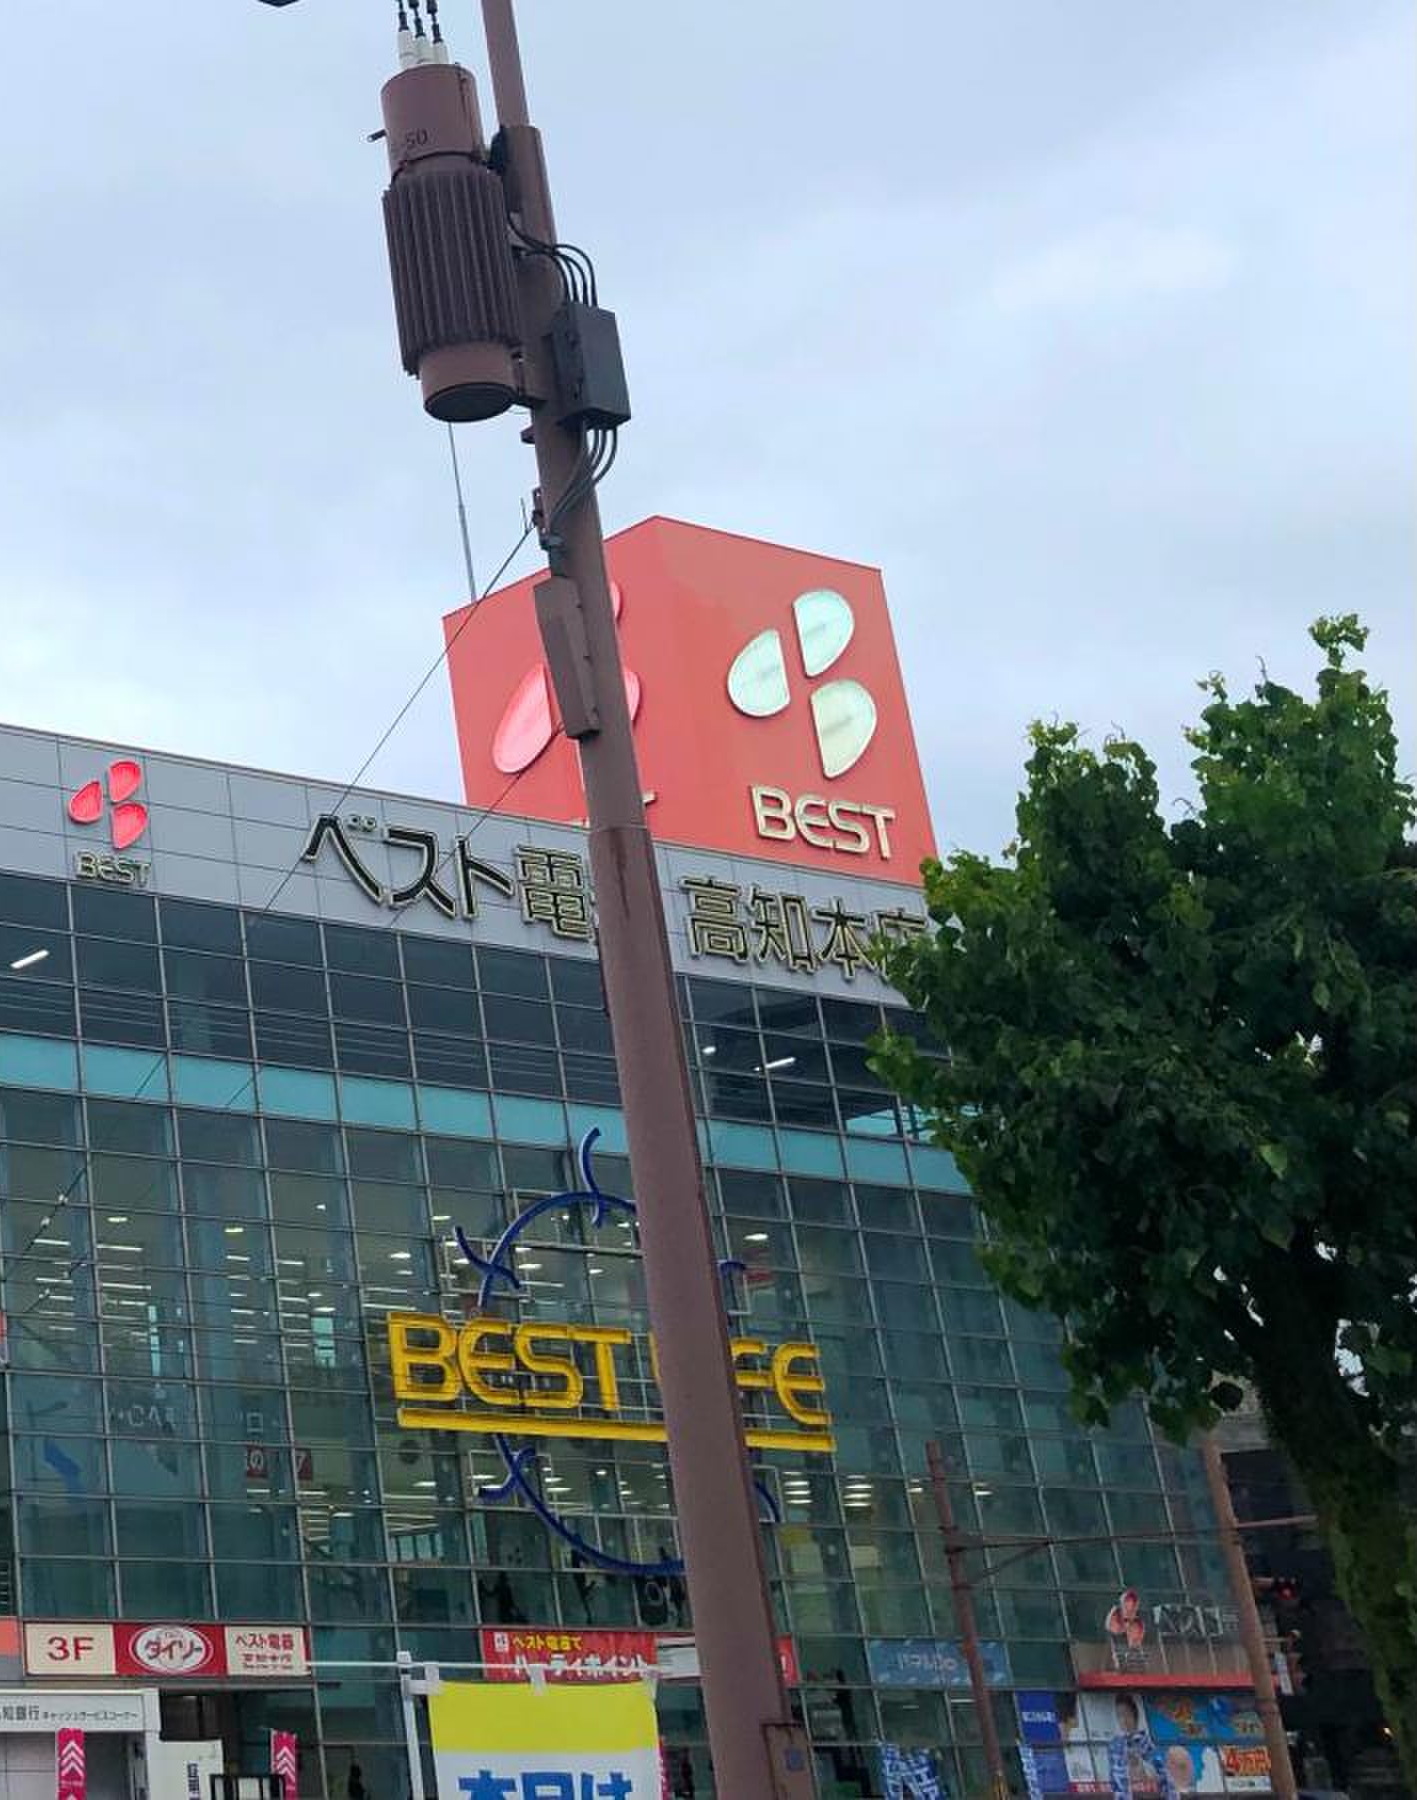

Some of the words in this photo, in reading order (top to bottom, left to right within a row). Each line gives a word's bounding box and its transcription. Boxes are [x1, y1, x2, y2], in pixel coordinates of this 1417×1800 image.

[750, 784, 896, 860] BEST
[77, 850, 150, 887] BEST
[304, 813, 597, 942] ベスト電
[387, 1311, 632, 1412] BEST
[47, 1636, 95, 1660] 3F
[145, 1640, 203, 1660] ダイソー
